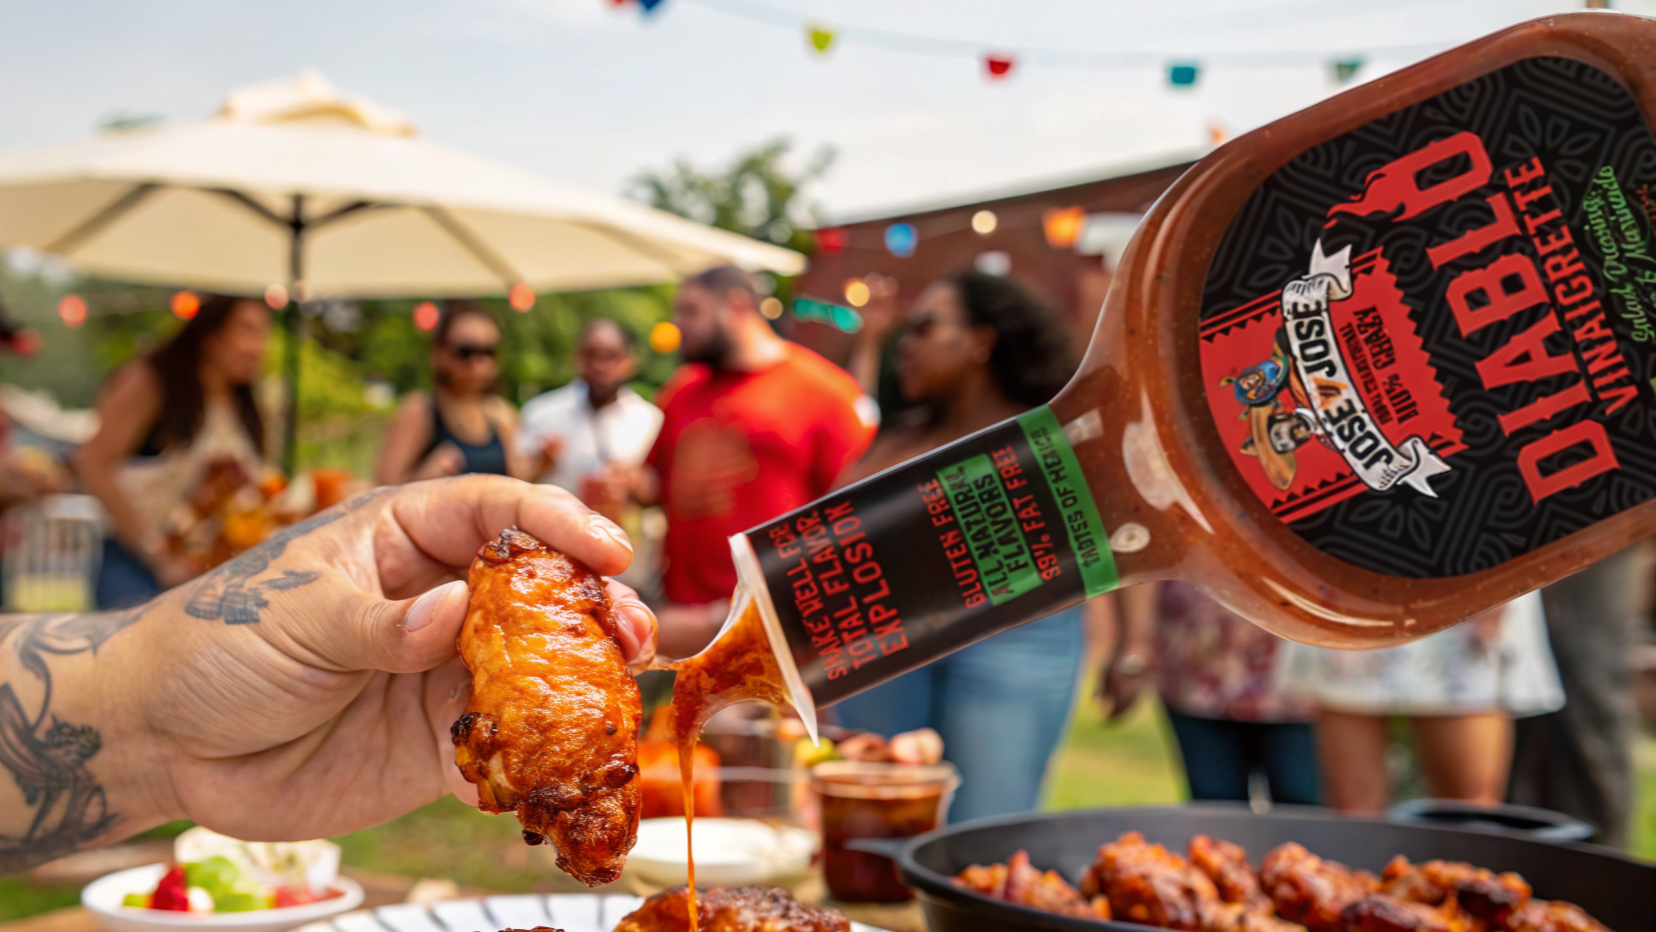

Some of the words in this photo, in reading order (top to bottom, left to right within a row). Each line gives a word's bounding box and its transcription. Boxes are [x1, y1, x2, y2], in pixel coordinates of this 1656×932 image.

[1335, 131, 1621, 506] DIABLO
[1504, 156, 1638, 416] VINAIGRETTE
[991, 444, 1027, 490] FREE
[1055, 487, 1078, 509] OF
[916, 478, 954, 527] FREE
[972, 473, 1029, 574] FLAVORS
[1012, 494, 1046, 533] FAT
[796, 510, 850, 596] FLAVOR
[824, 501, 909, 656] EXPLOSION
[940, 529, 987, 608] GLUTEN
[984, 560, 1015, 596] ALL
[1031, 534, 1062, 580] 99%
[787, 557, 824, 618] WELL
[833, 595, 877, 670] TOTAL
